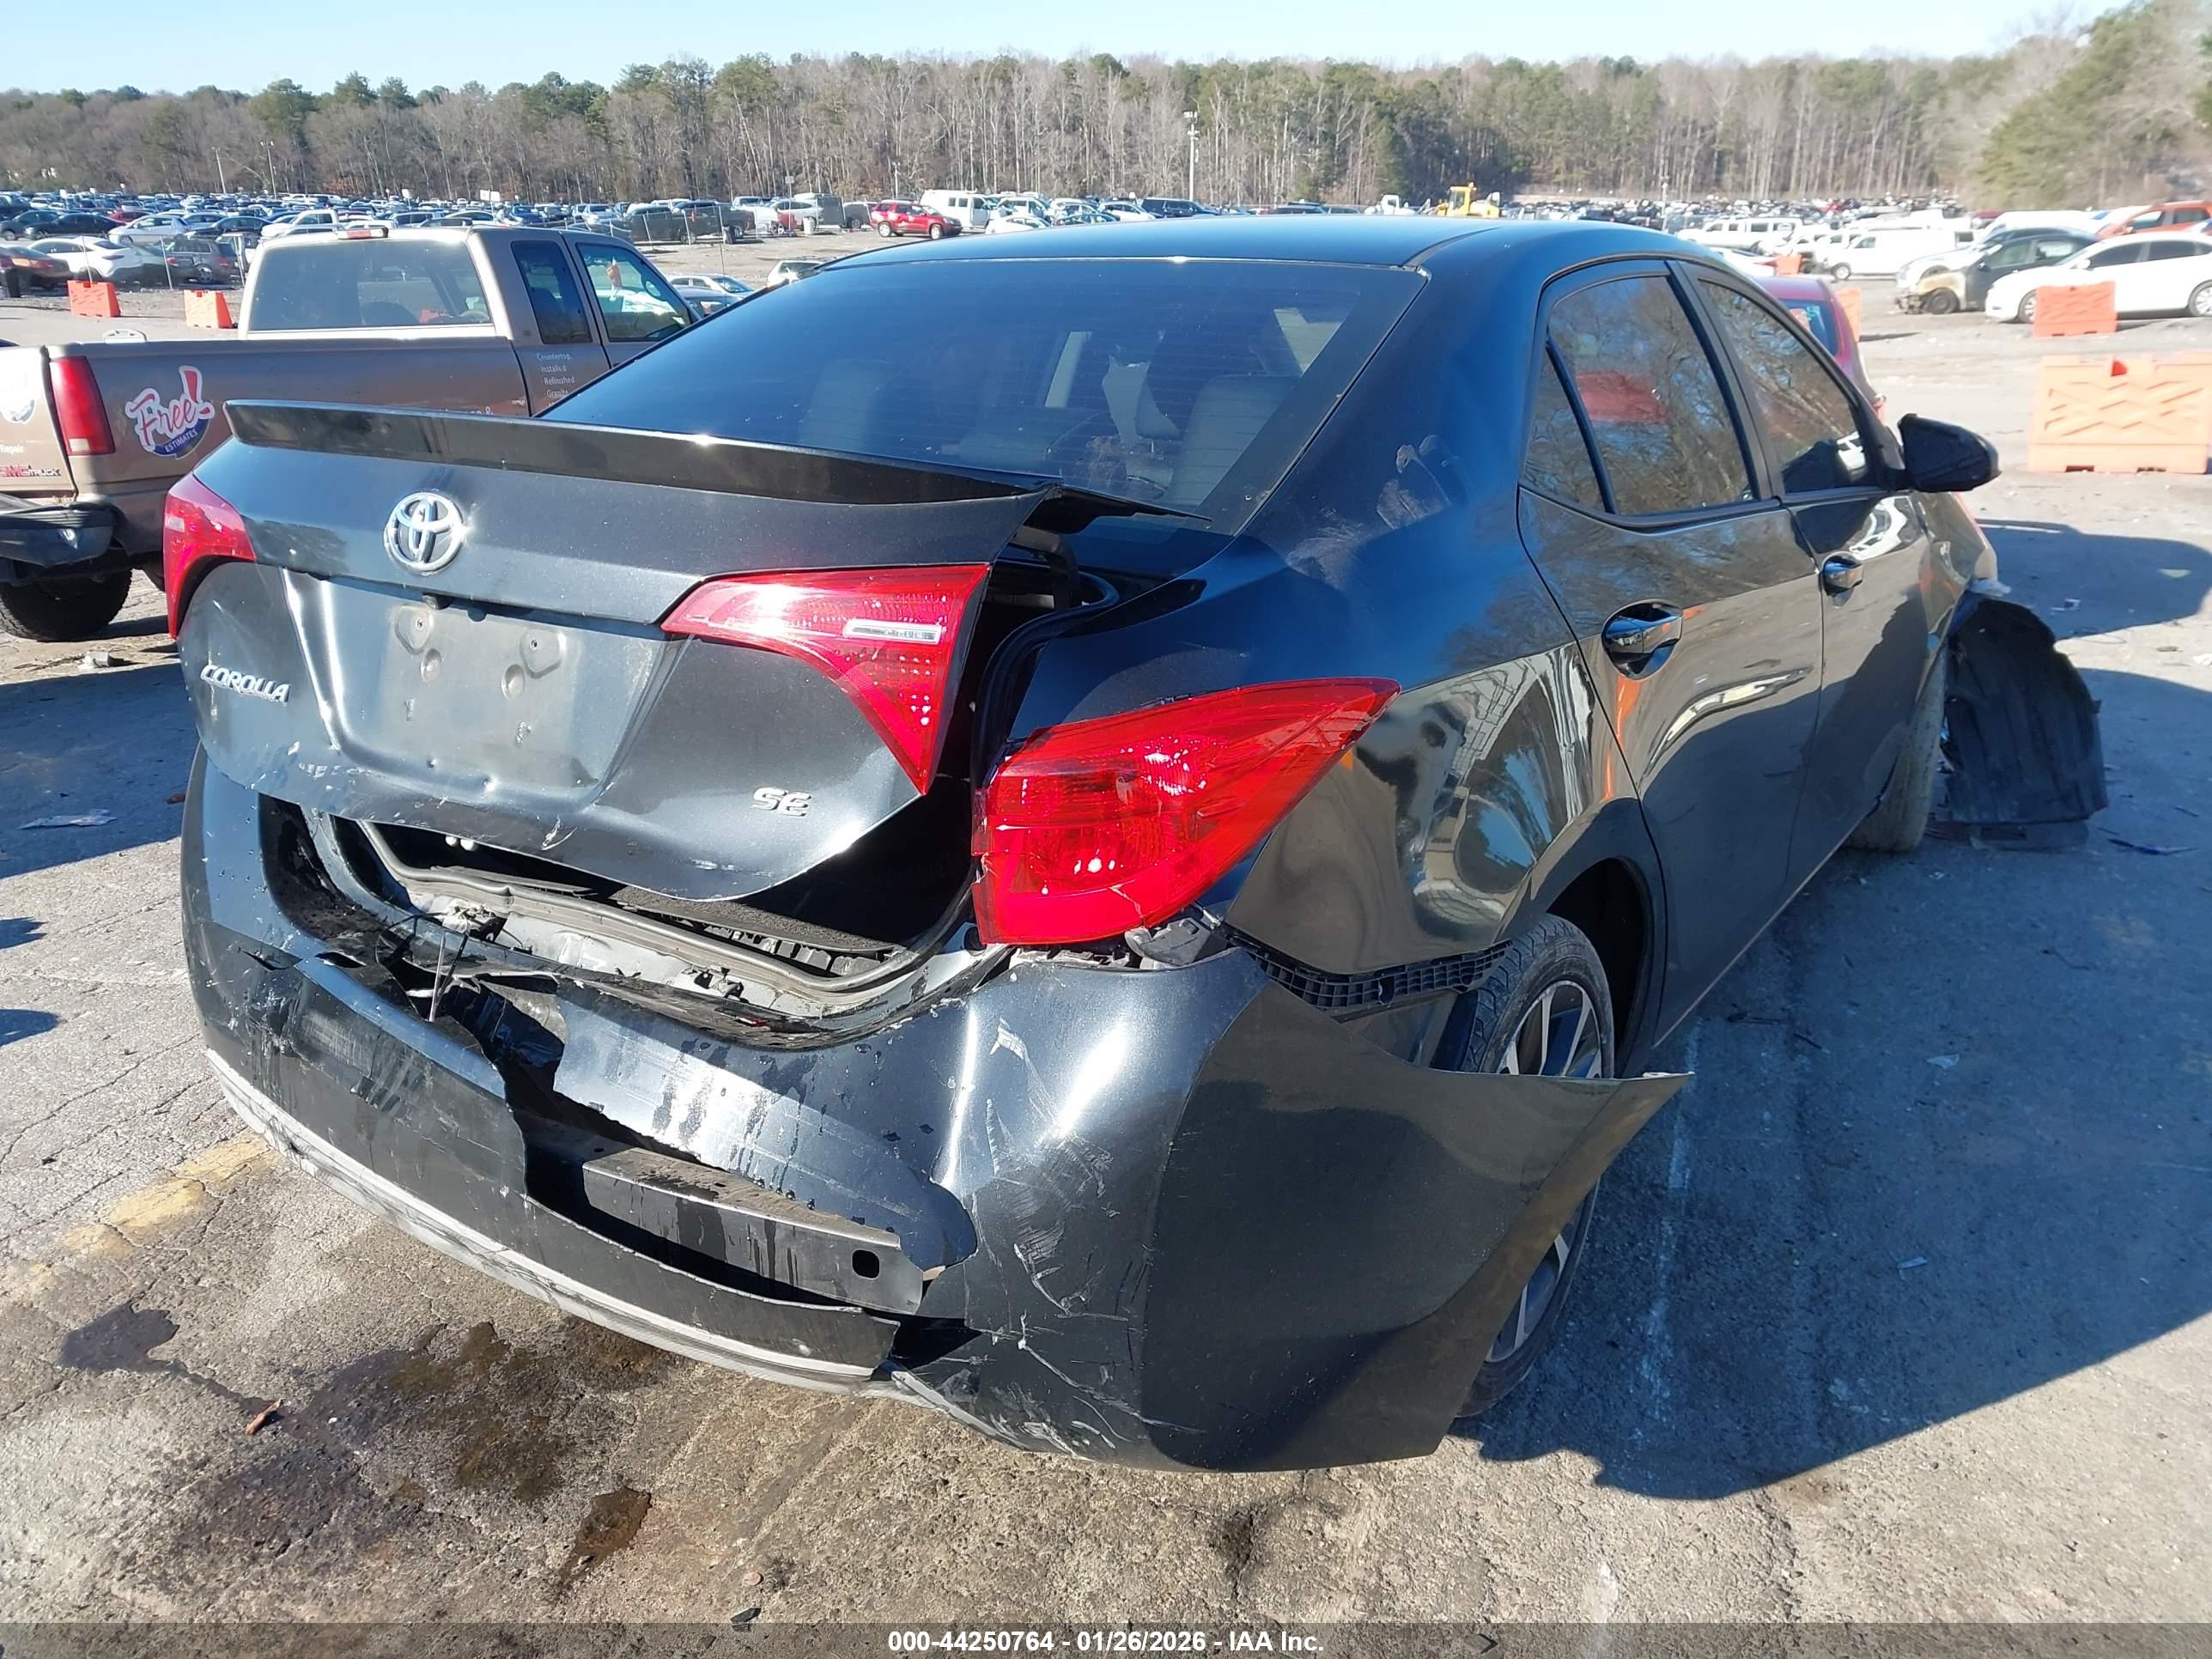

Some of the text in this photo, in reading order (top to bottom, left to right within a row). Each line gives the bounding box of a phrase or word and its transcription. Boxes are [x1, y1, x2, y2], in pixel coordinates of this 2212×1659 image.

[127, 368, 213, 448] Free!
[164, 428, 198, 453] ESTIMATES
[200, 665, 292, 705] COROLLA
[750, 783, 812, 817] SE
